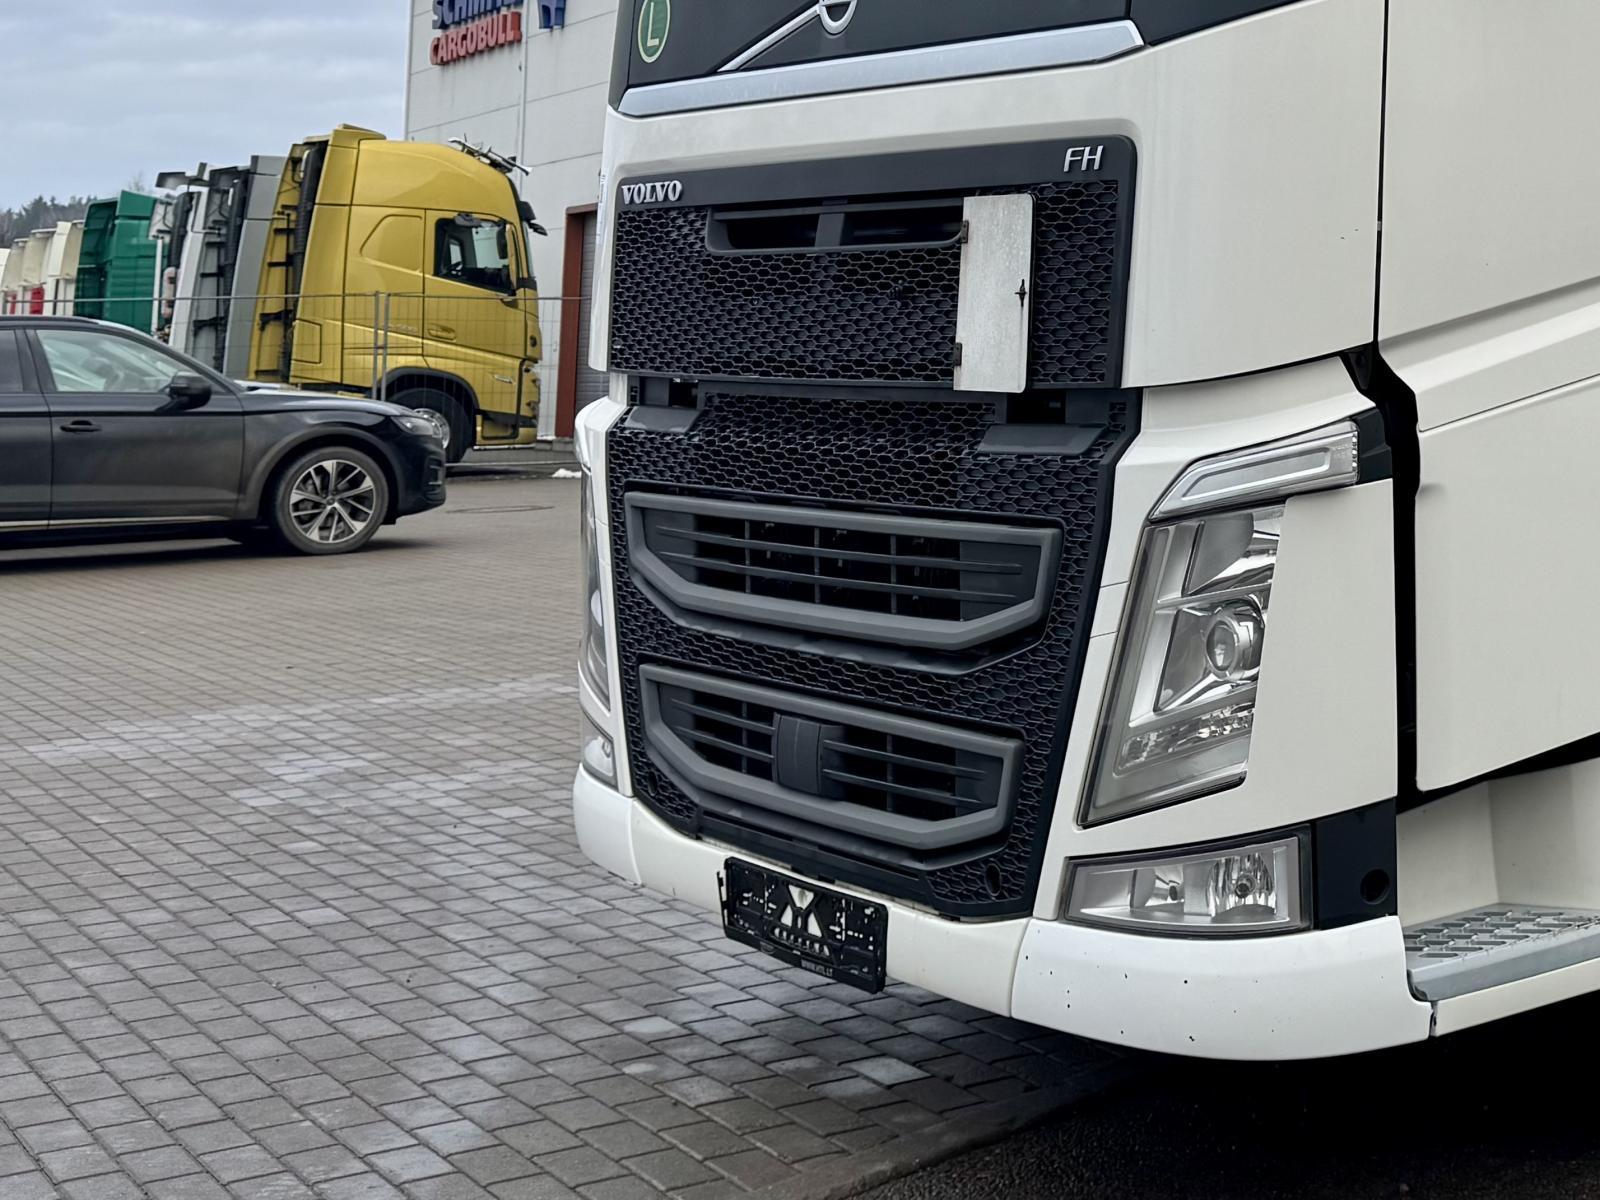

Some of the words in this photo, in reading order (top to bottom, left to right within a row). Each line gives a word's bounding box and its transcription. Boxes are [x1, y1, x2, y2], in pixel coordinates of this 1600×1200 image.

[429, 11, 522, 66] CARGOBULL
[1063, 144, 1104, 172] FH
[621, 179, 683, 205] VOLVO
